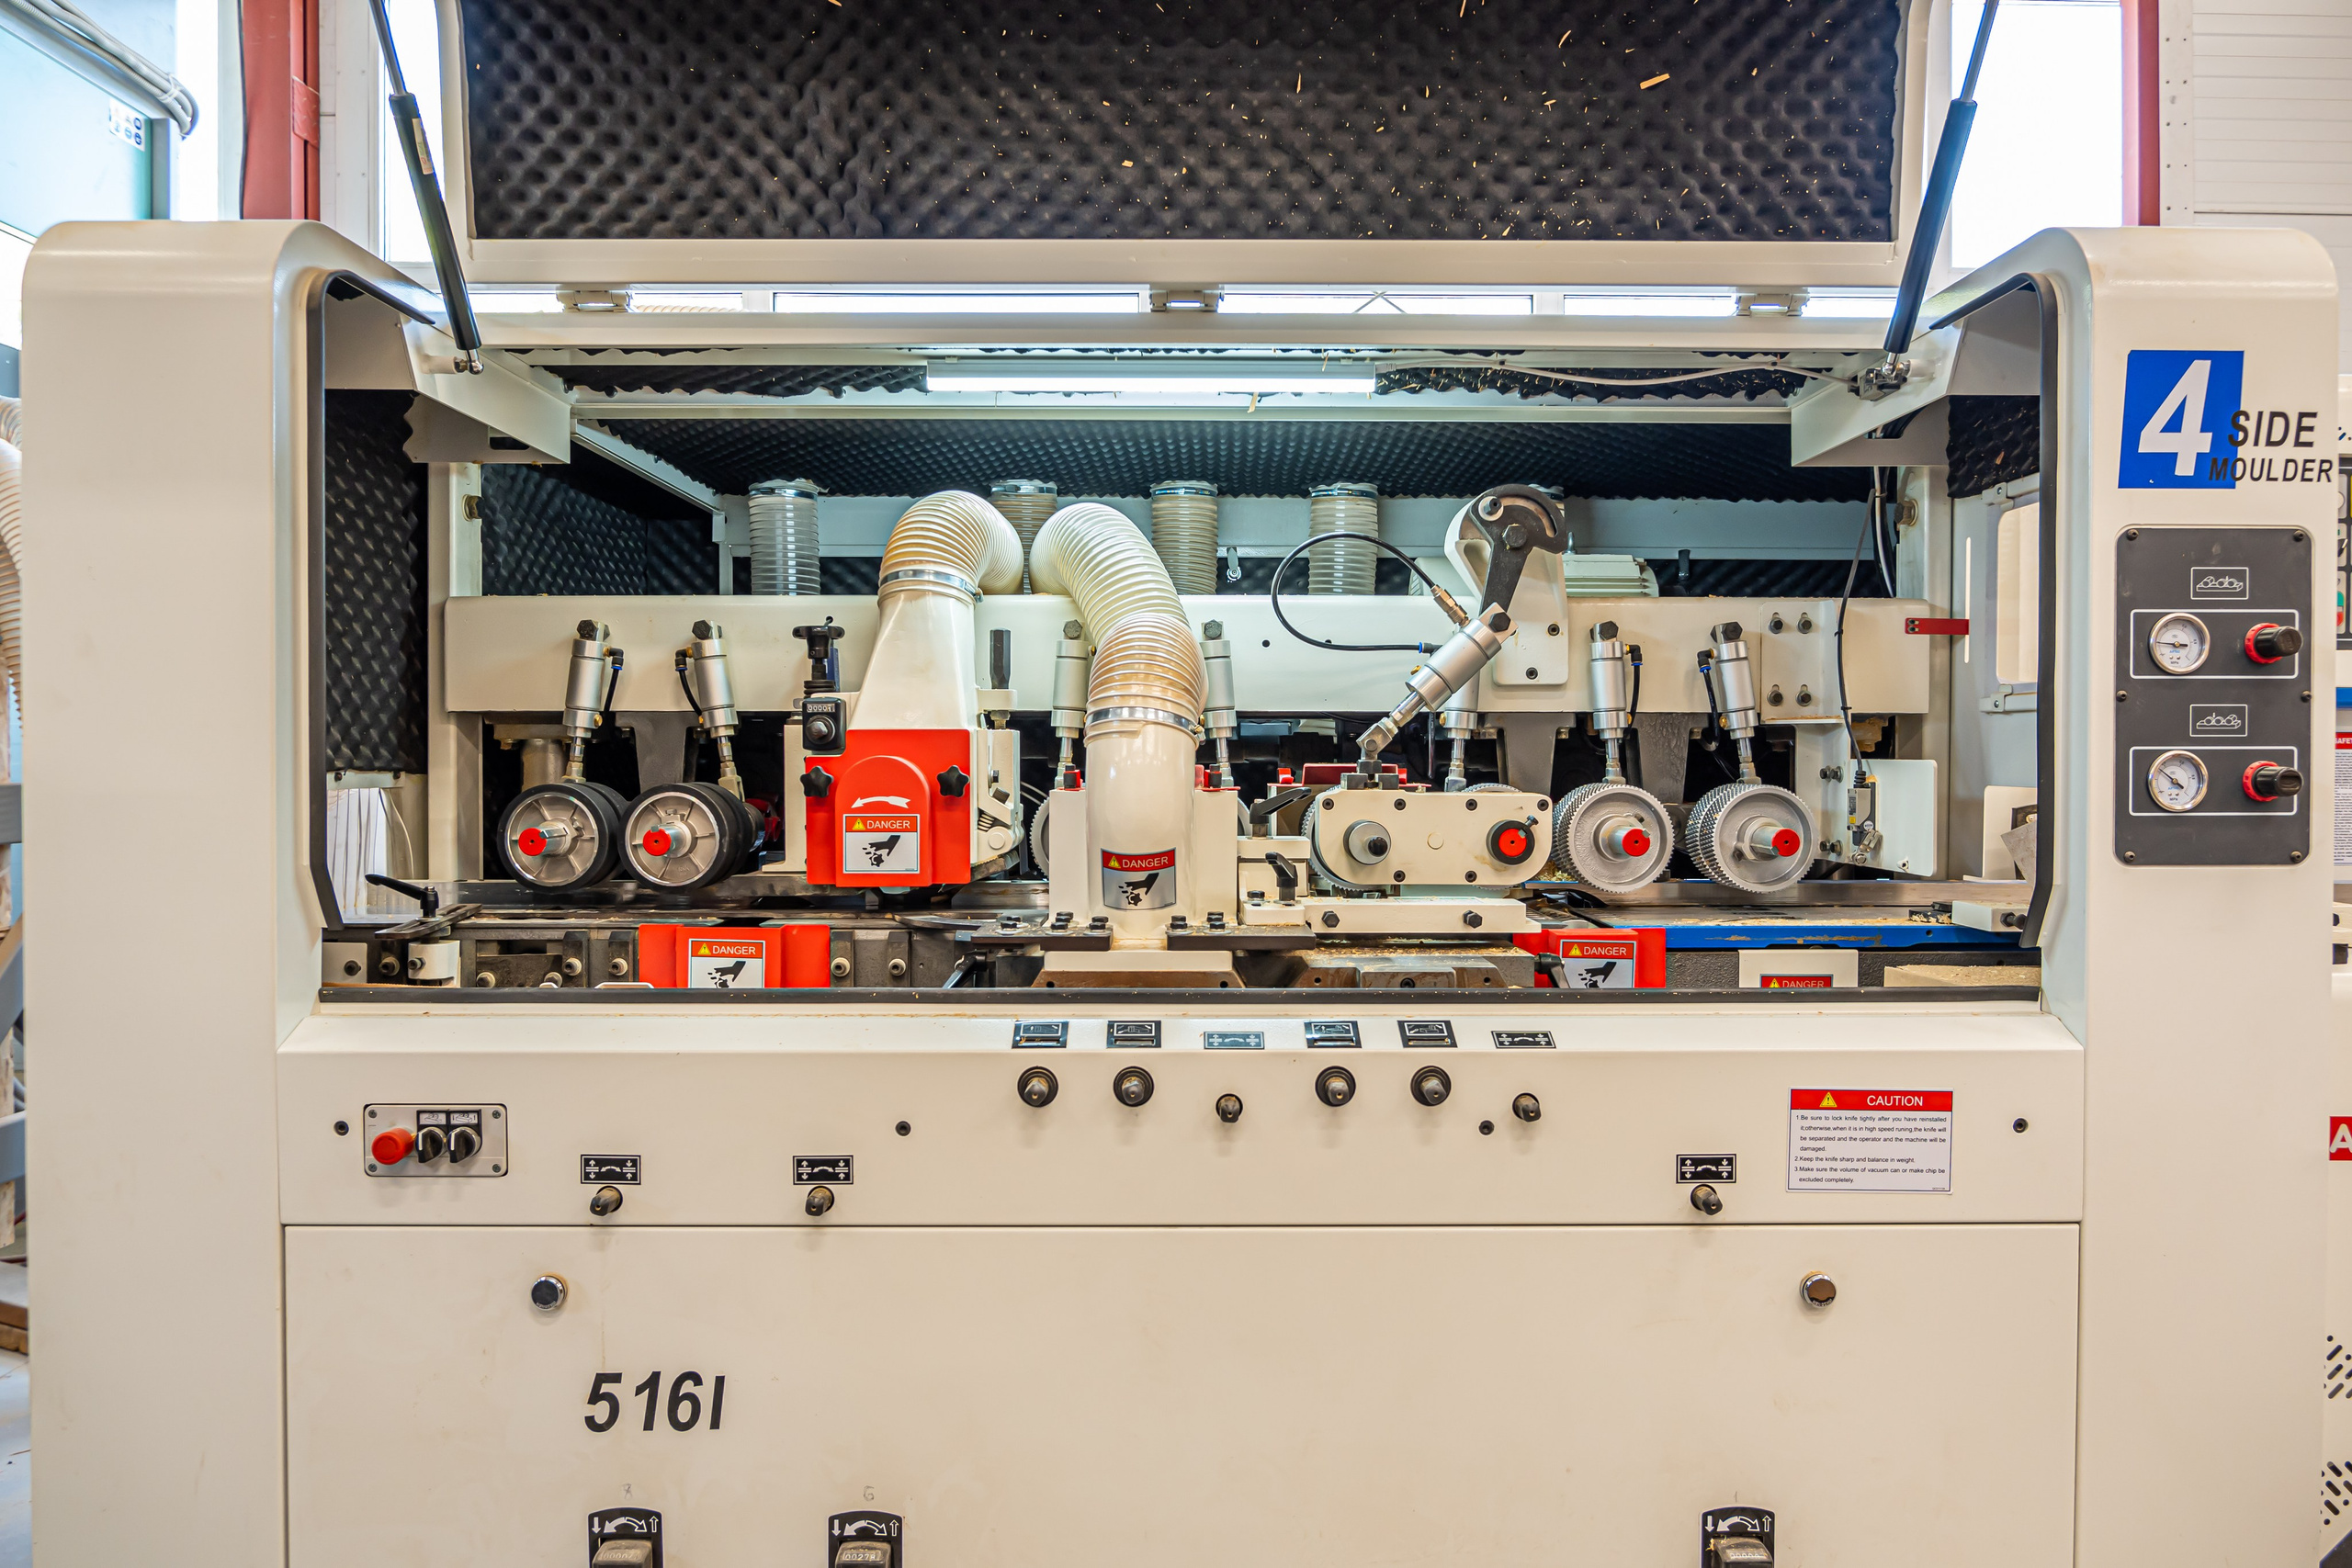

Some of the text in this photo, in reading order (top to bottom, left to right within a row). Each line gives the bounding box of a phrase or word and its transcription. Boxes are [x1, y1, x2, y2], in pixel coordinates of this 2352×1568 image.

[2138, 359, 2318, 476] 4 SIDE
[2208, 457, 2334, 482] MOULDER
[866, 820, 910, 829] DANGER
[1122, 856, 1169, 868] DANGER
[712, 945, 756, 955] DANGER
[1583, 946, 1627, 955] DANGER
[1867, 1095, 1923, 1106] CAUTION
[1865, 1125, 1876, 1134] high
